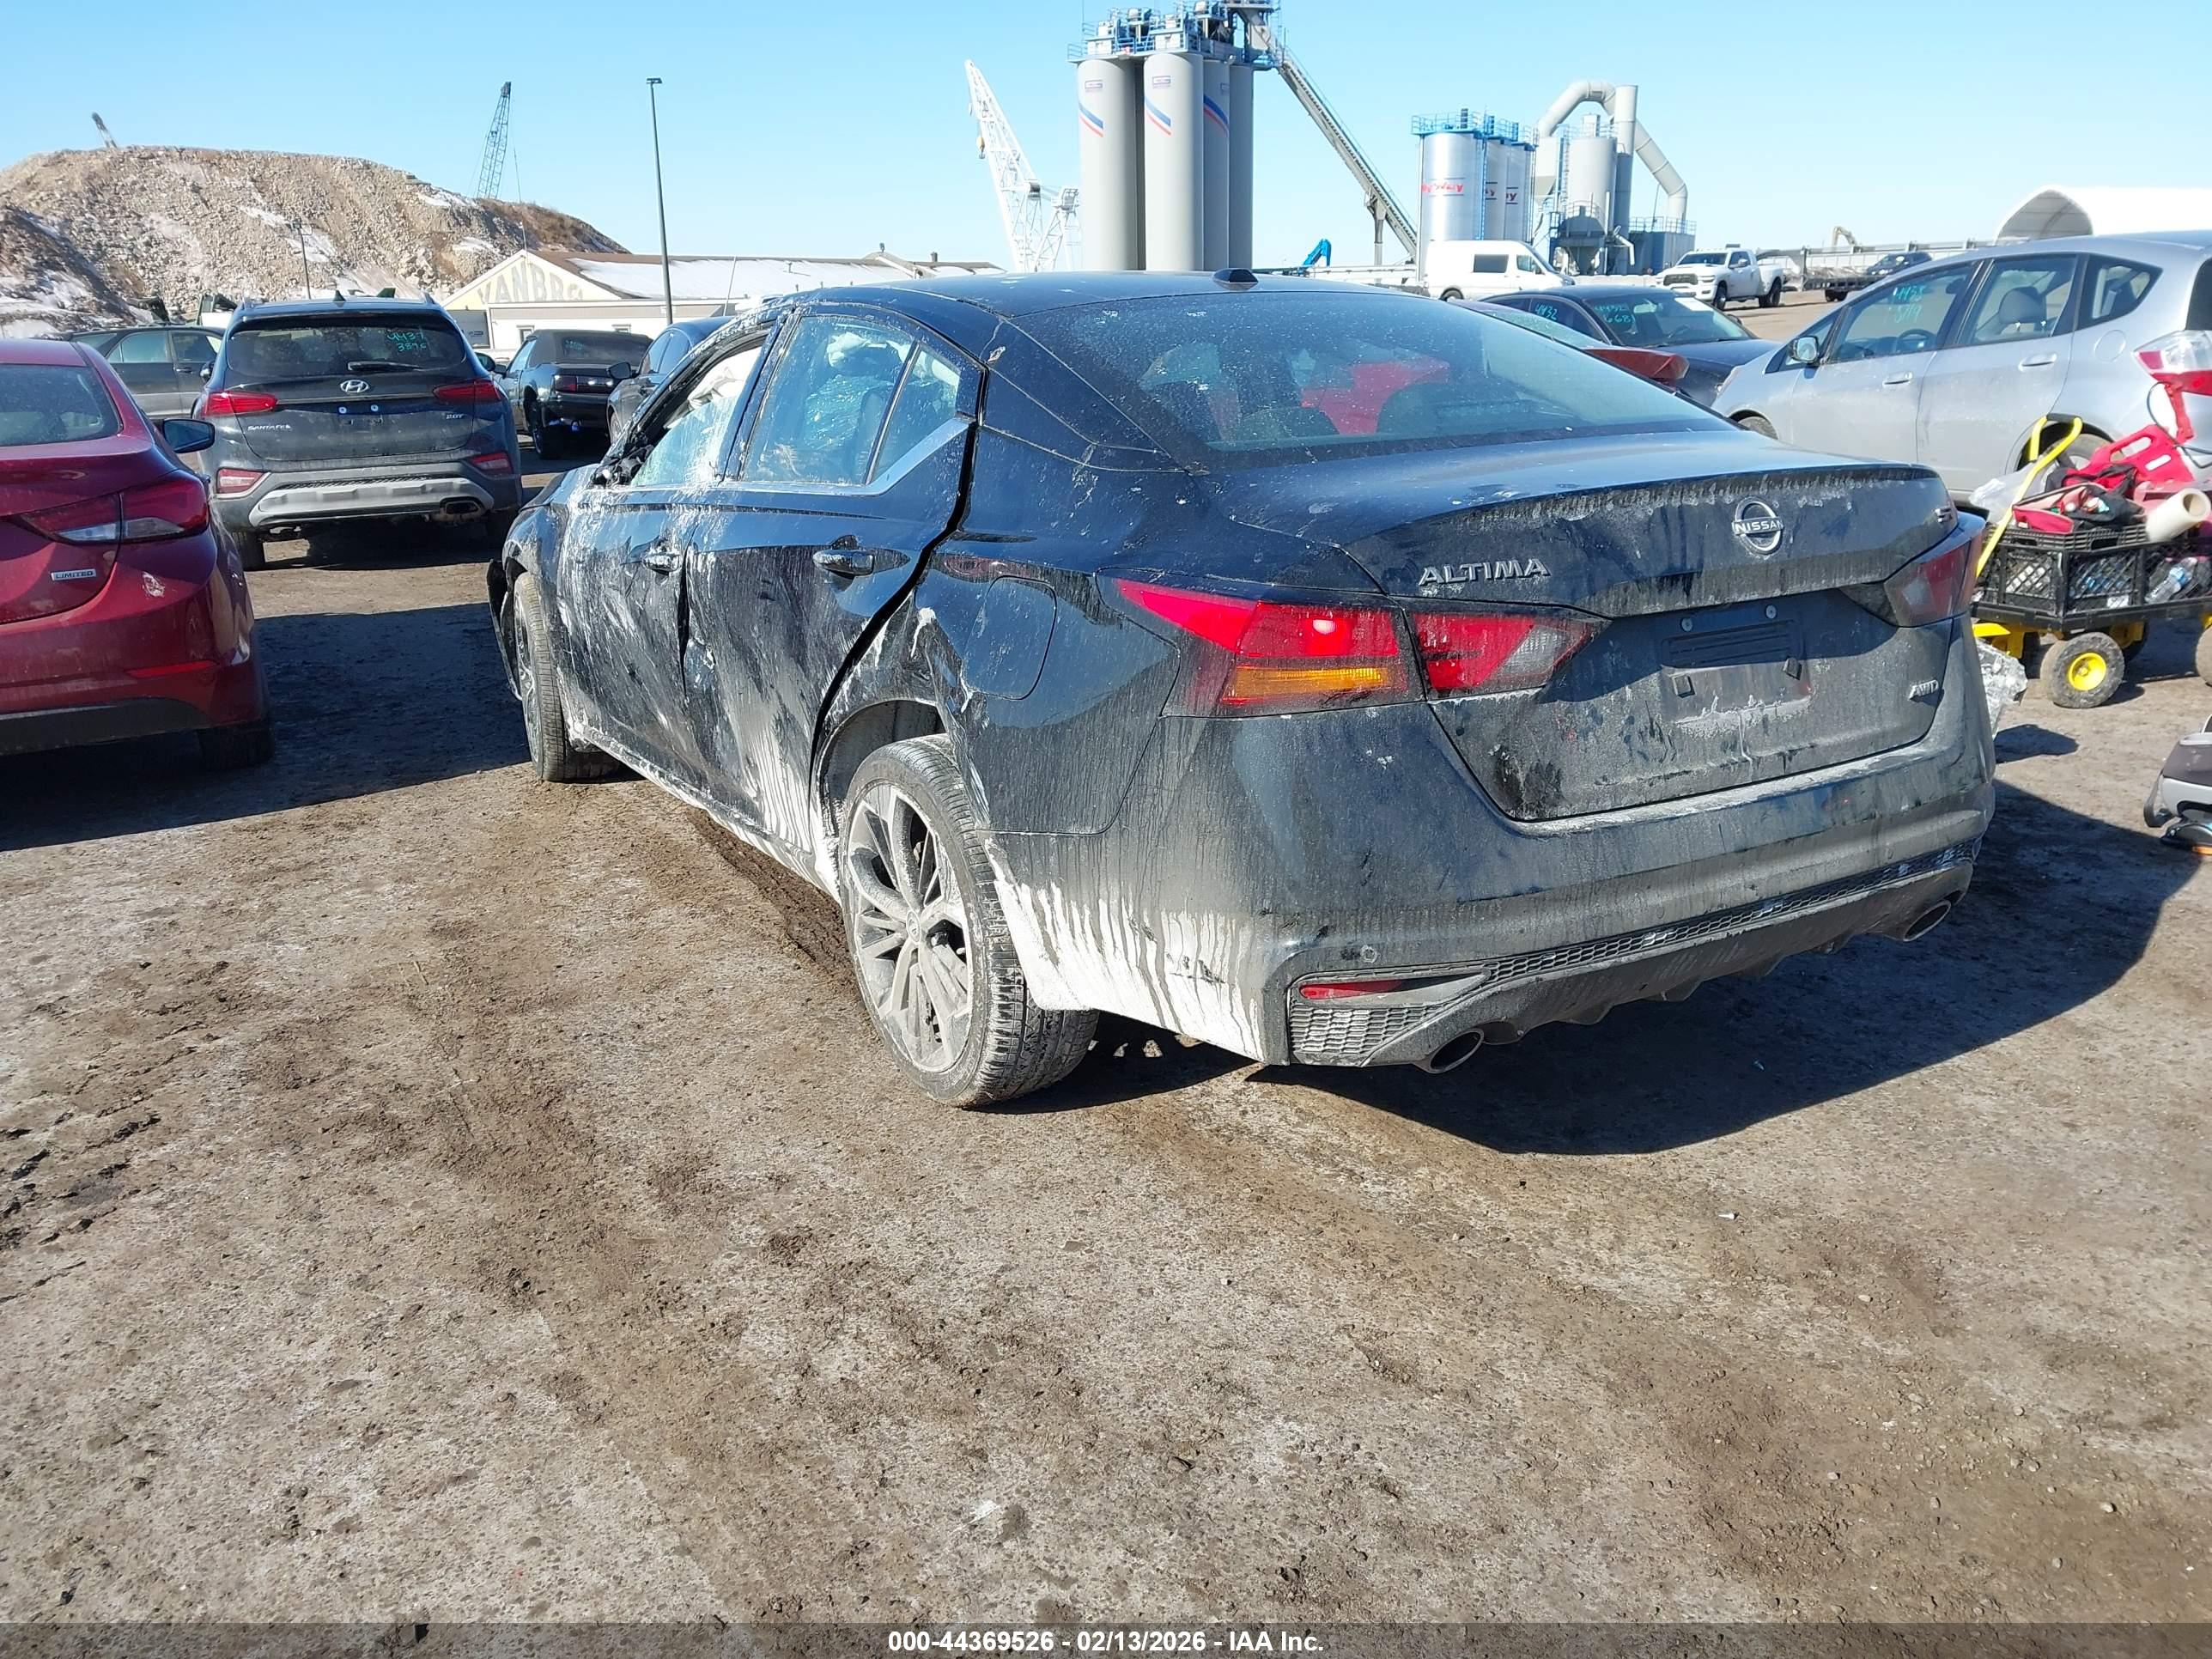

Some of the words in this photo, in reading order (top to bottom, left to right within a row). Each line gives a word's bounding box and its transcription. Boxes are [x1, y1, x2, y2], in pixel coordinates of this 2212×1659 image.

[1735, 520, 1784, 532] NISSAN
[54, 570, 94, 579] LIMITED
[1419, 558, 1552, 586] ALTIMA
[1909, 679, 1938, 699] AWD
